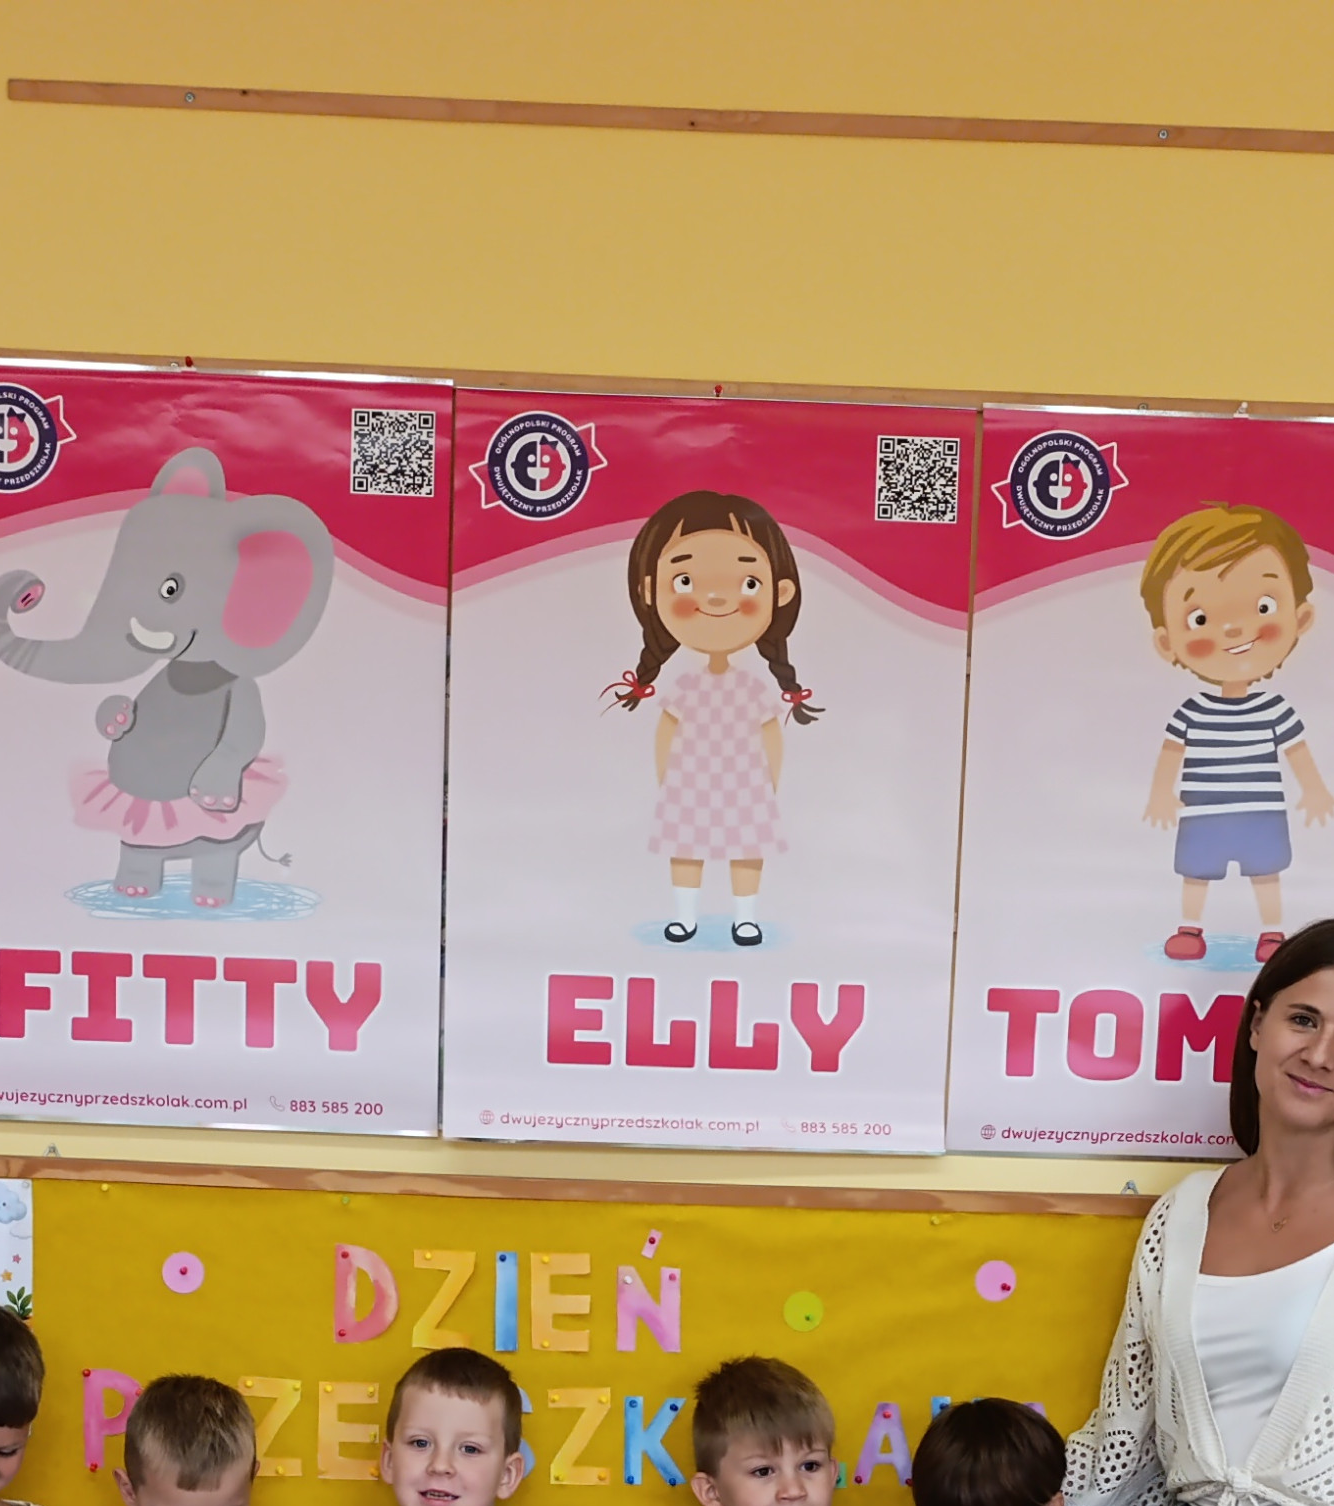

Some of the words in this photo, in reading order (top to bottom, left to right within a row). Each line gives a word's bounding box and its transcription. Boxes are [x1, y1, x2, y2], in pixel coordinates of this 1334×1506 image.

[19, 395, 50, 430] PROGRAM
[495, 420, 550, 454] OGÓLNOPOLSKI
[551, 423, 582, 457] PROGRAM
[4, 442, 51, 485] PRZEDSZKOLAK
[1018, 439, 1073, 474] OGÓLNOPOLSKI
[1074, 442, 1103, 476] PROGRAM
[536, 469, 583, 513] PRZEDSZKOLAK
[1057, 488, 1105, 532] PRZEDSZKOLAK
[546, 973, 866, 1073] ELLY
[289, 1099, 317, 1114] 883
[322, 1100, 350, 1115] 585
[354, 1101, 384, 1116] 200
[499, 1111, 761, 1133] dwujezycznyprzedszkolak.com.pl
[800, 1120, 827, 1135] 883
[831, 1121, 859, 1136] 585
[864, 1122, 893, 1137] 200
[333, 1229, 682, 1353] DZIEŃ
